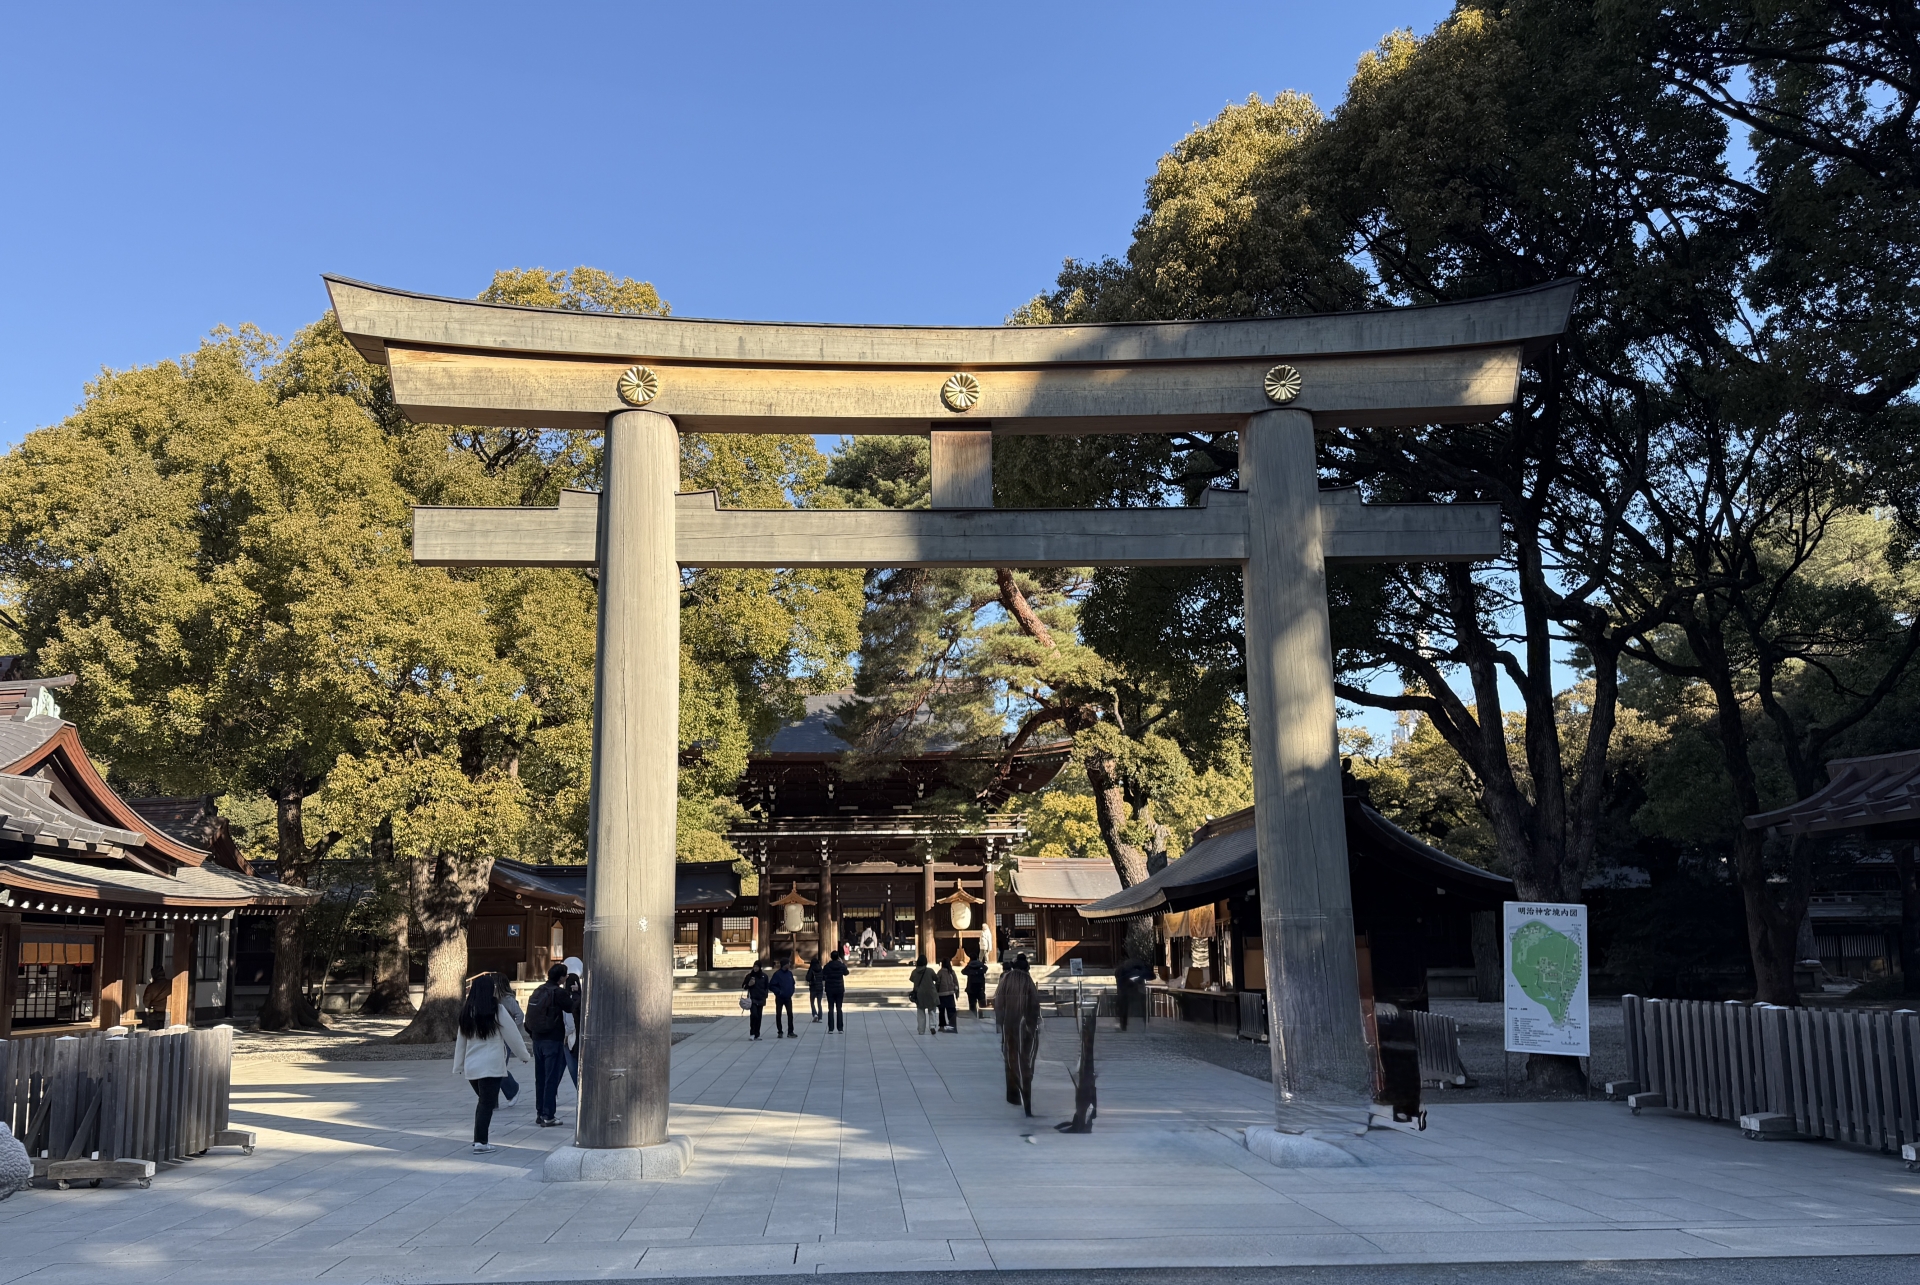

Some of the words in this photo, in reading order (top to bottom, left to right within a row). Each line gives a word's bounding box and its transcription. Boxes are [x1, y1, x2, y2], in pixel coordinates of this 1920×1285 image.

[1518, 907, 1578, 917] 明治神宮境内図
